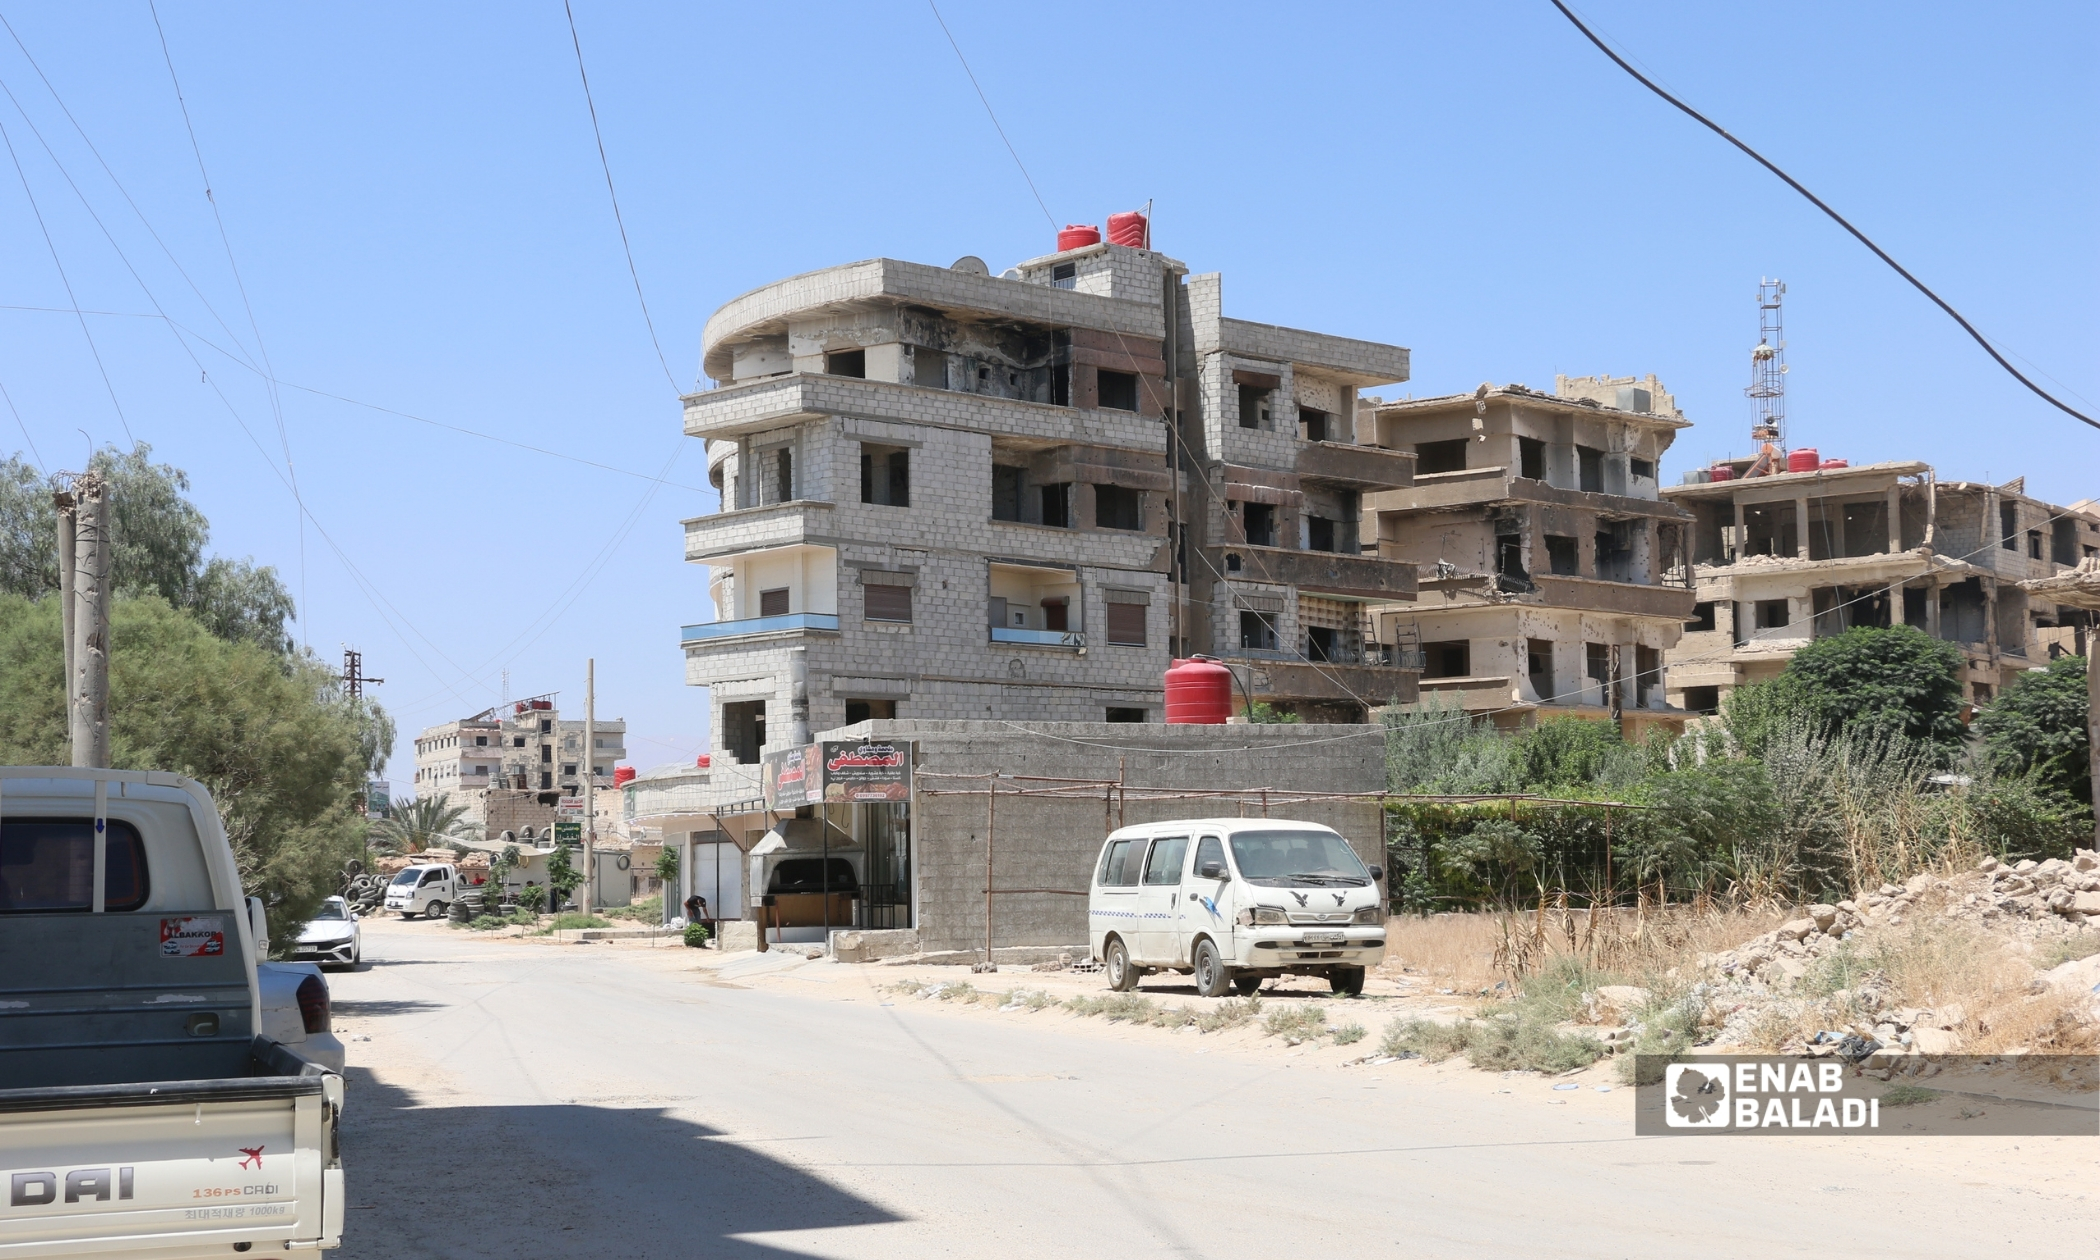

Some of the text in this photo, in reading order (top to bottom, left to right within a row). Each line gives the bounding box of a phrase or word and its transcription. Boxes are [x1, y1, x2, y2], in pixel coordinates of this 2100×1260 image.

[827, 751, 904, 770] المصطفى
[10, 1166, 134, 1207] DAI
[184, 1206, 285, 1220] 최대적재량 1000kg
